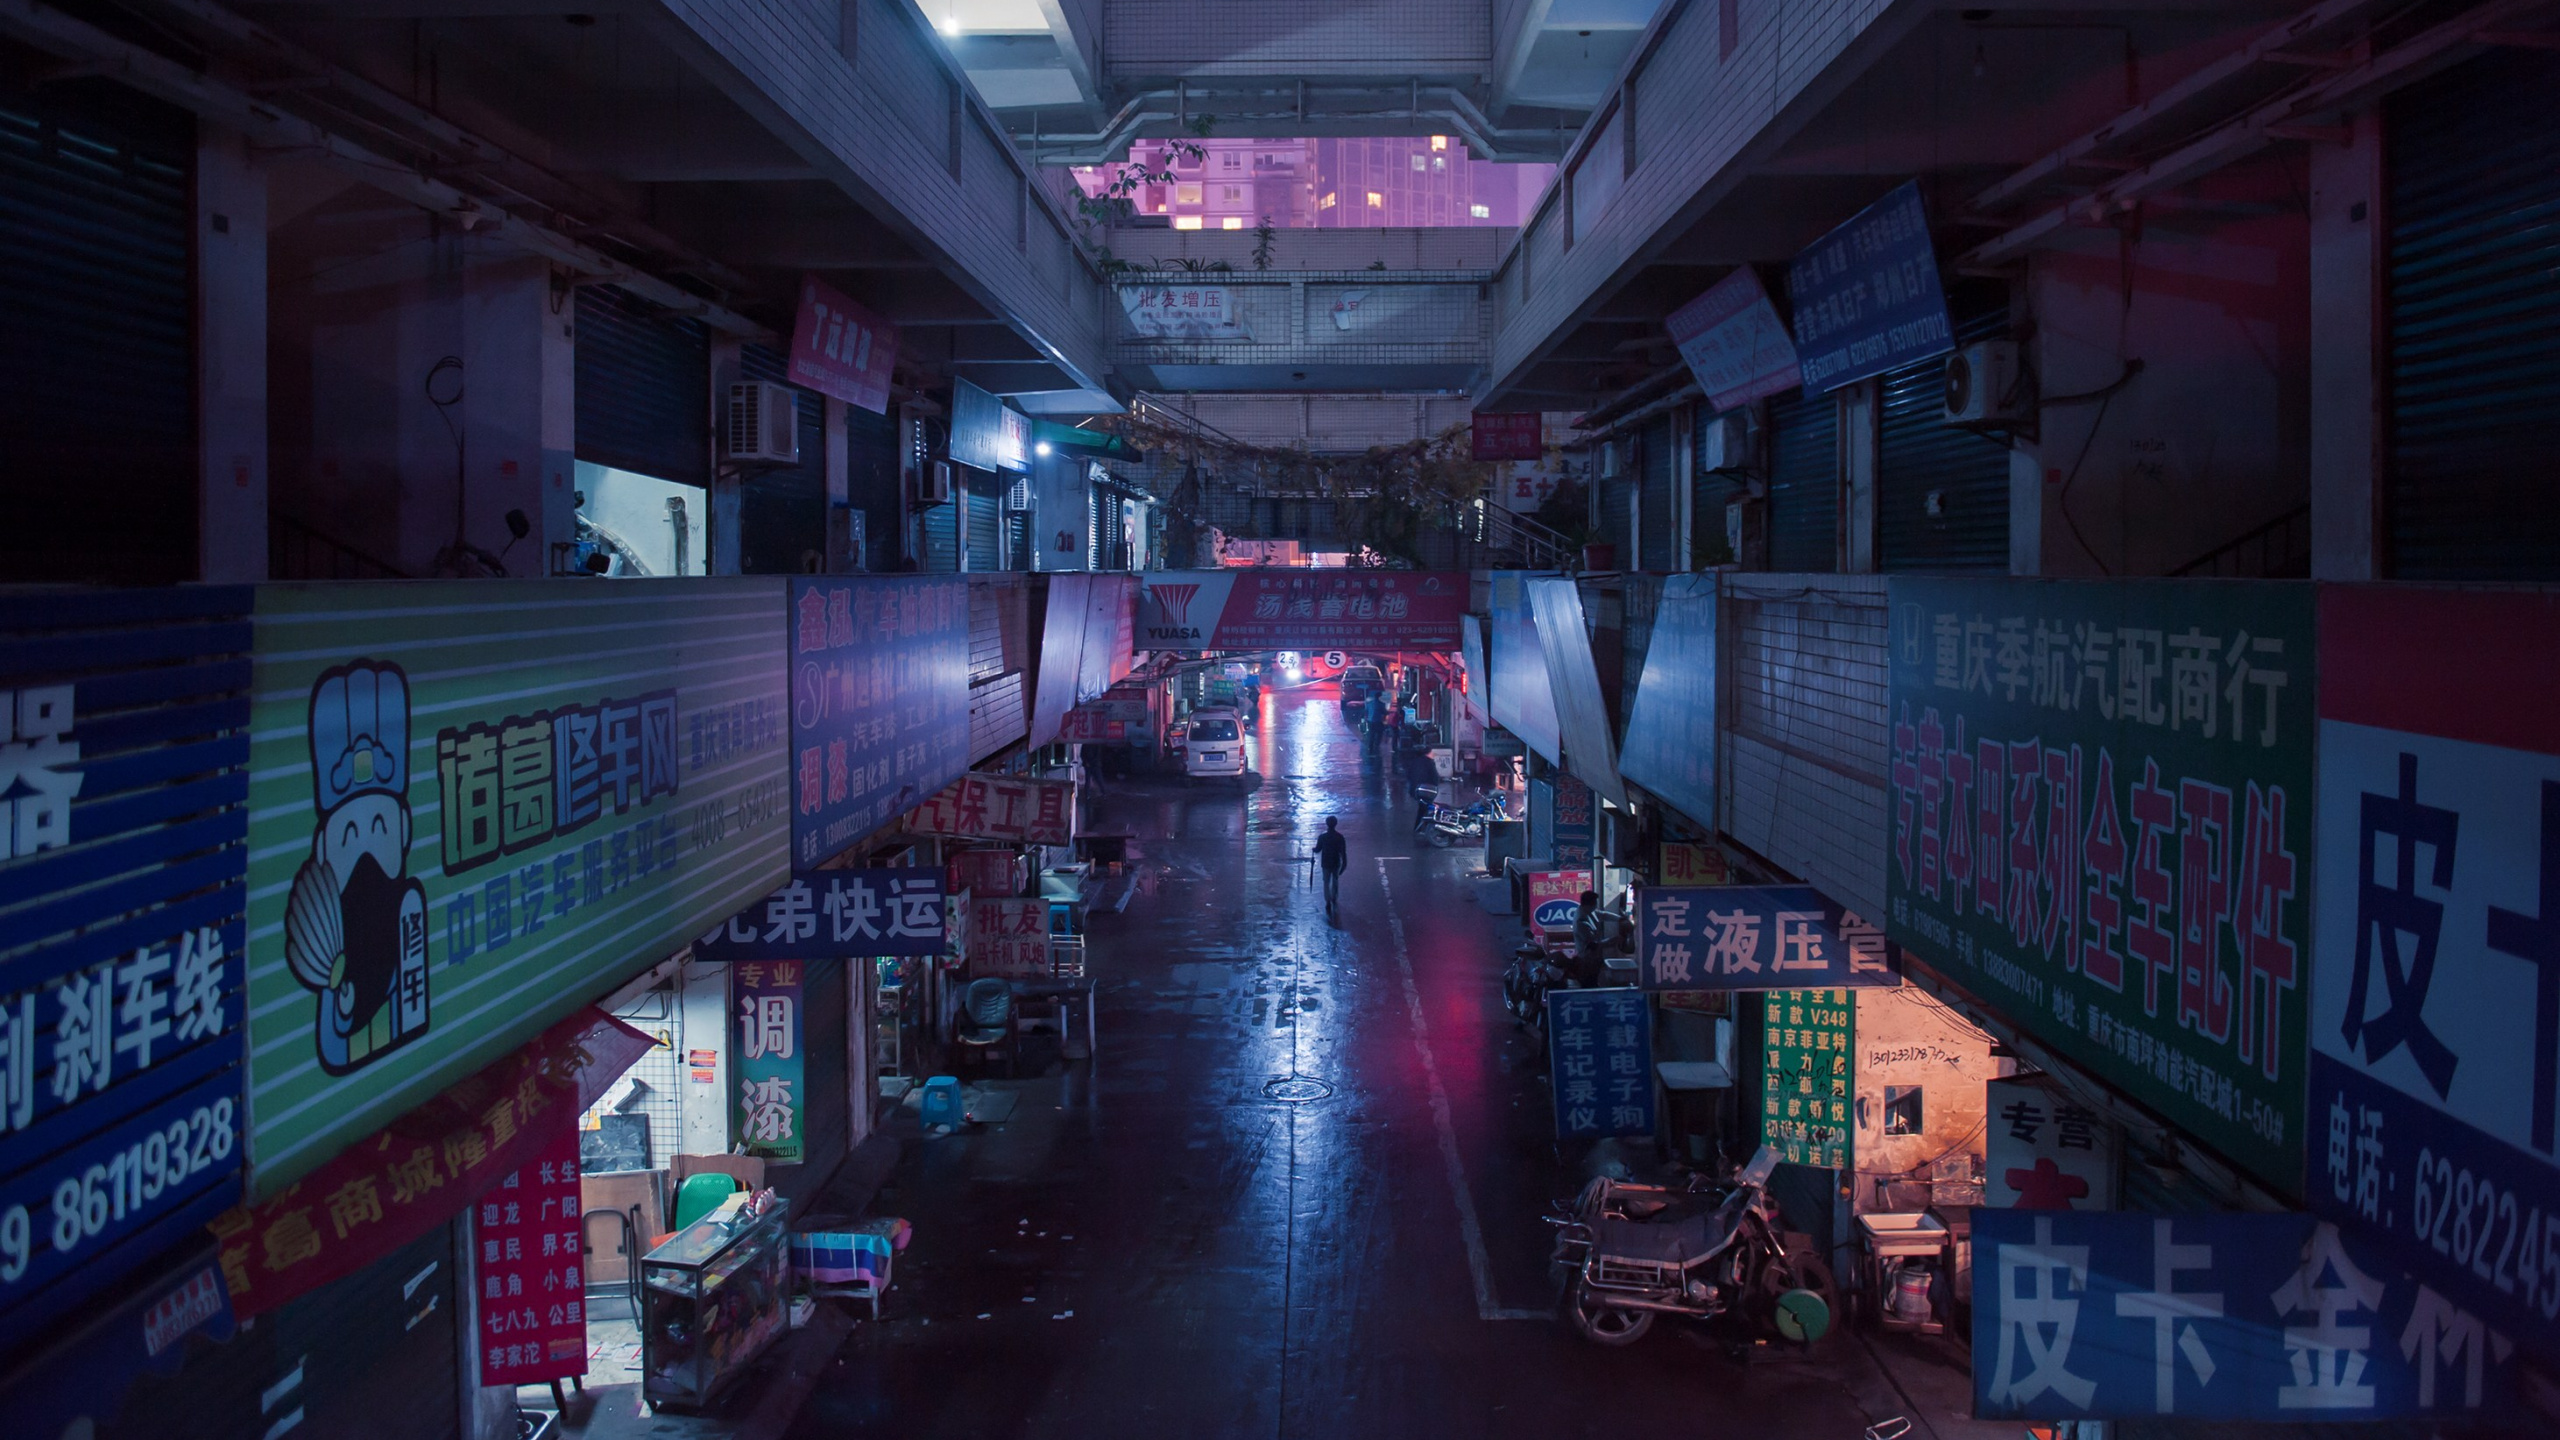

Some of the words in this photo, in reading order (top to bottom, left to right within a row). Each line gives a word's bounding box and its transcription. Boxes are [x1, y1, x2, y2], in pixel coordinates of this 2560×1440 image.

[1139, 290, 1221, 308] 批发增压
[1253, 591, 1409, 620] 汤浅蓄电池
[1147, 626, 1202, 640] YUASA
[1328, 652, 1341, 666] 5
[1933, 608, 2288, 748] 重庆季航汽配商行
[438, 690, 678, 875] 诸葛修车网
[799, 737, 848, 816] 调漆
[909, 776, 1066, 839] 汽保工具
[1665, 842, 1728, 882] 凯马
[447, 814, 678, 966] 中国汽车服务平台
[1892, 702, 2296, 1082] 专营本田系列全车配件
[977, 904, 1042, 935] 批发
[1539, 907, 1578, 923] JAC
[401, 911, 424, 1012] 修车
[1651, 895, 1692, 986] 定做
[1703, 908, 1888, 975] 液压管
[738, 962, 796, 988] 专业
[1767, 1027, 1847, 1052] 南京菲亚特
[739, 996, 794, 1142] 调漆
[1558, 1000, 1600, 1132] 行车记录仪
[1604, 999, 1645, 1129] 车载电子狗
[2001, 1101, 2097, 1151] 专营
[52, 1096, 234, 1253] 86119328
[540, 1160, 577, 1186] 长生
[2328, 1091, 2395, 1227] 电话：
[482, 1201, 521, 1227] 迎龙
[541, 1196, 578, 1222] 广阳
[484, 1237, 522, 1263] 惠民
[542, 1232, 579, 1257] 界石
[485, 1273, 523, 1299] 鹿角
[543, 1266, 580, 1293] 小泉
[486, 1307, 539, 1335] 七八九
[548, 1301, 582, 1327] 公里
[488, 1342, 542, 1370] 李家沱
